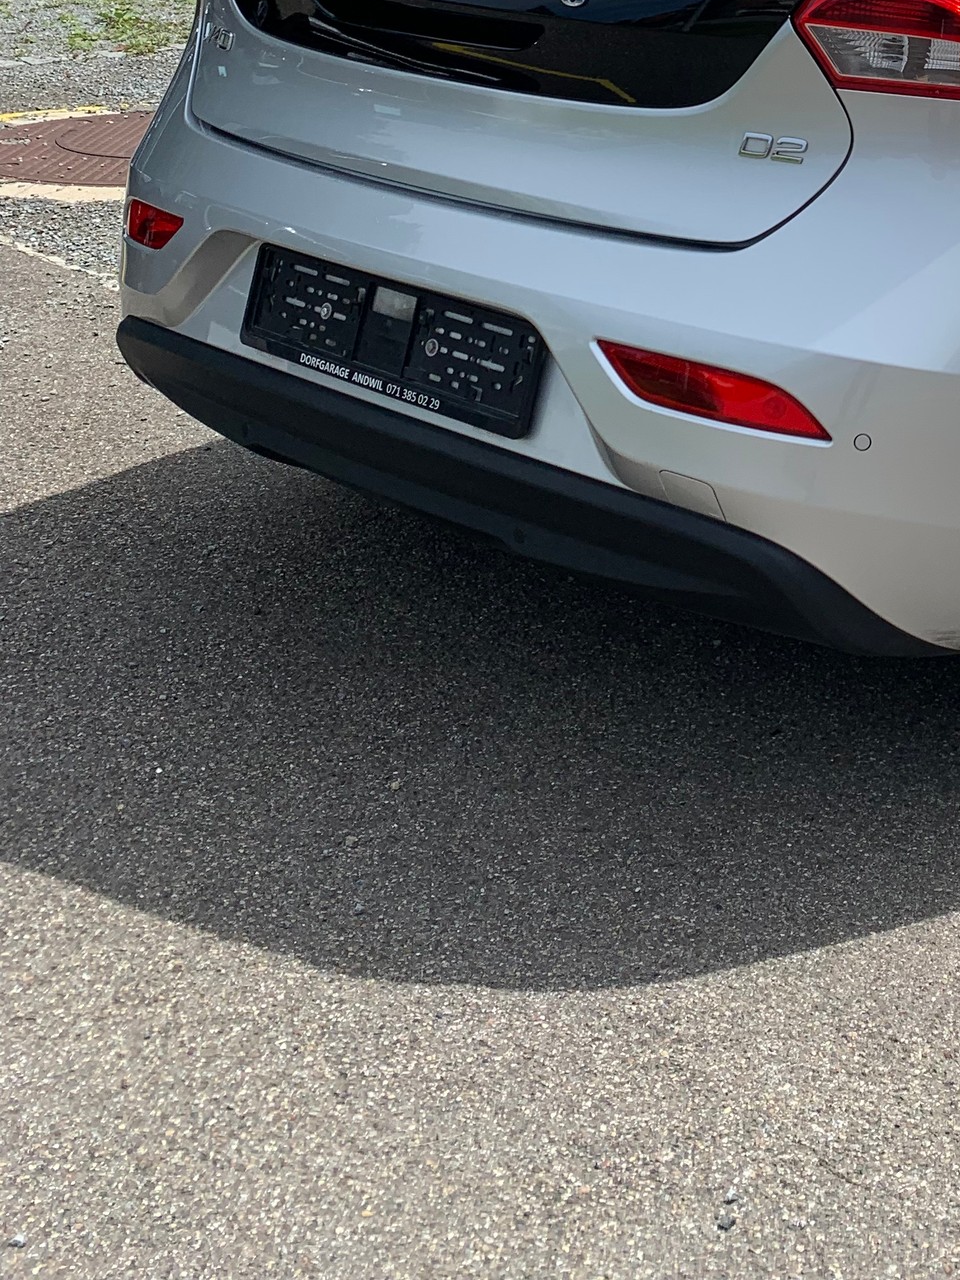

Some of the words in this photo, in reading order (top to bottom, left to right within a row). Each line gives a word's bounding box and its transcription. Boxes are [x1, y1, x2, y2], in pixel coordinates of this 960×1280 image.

[738, 131, 809, 165] D2
[300, 352, 350, 380] DORFGARAGE
[352, 371, 383, 391] ANDWIL
[386, 382, 401, 397] 071
[401, 388, 417, 403] 385
[417, 394, 429, 407] 02
[429, 398, 441, 410] 29
